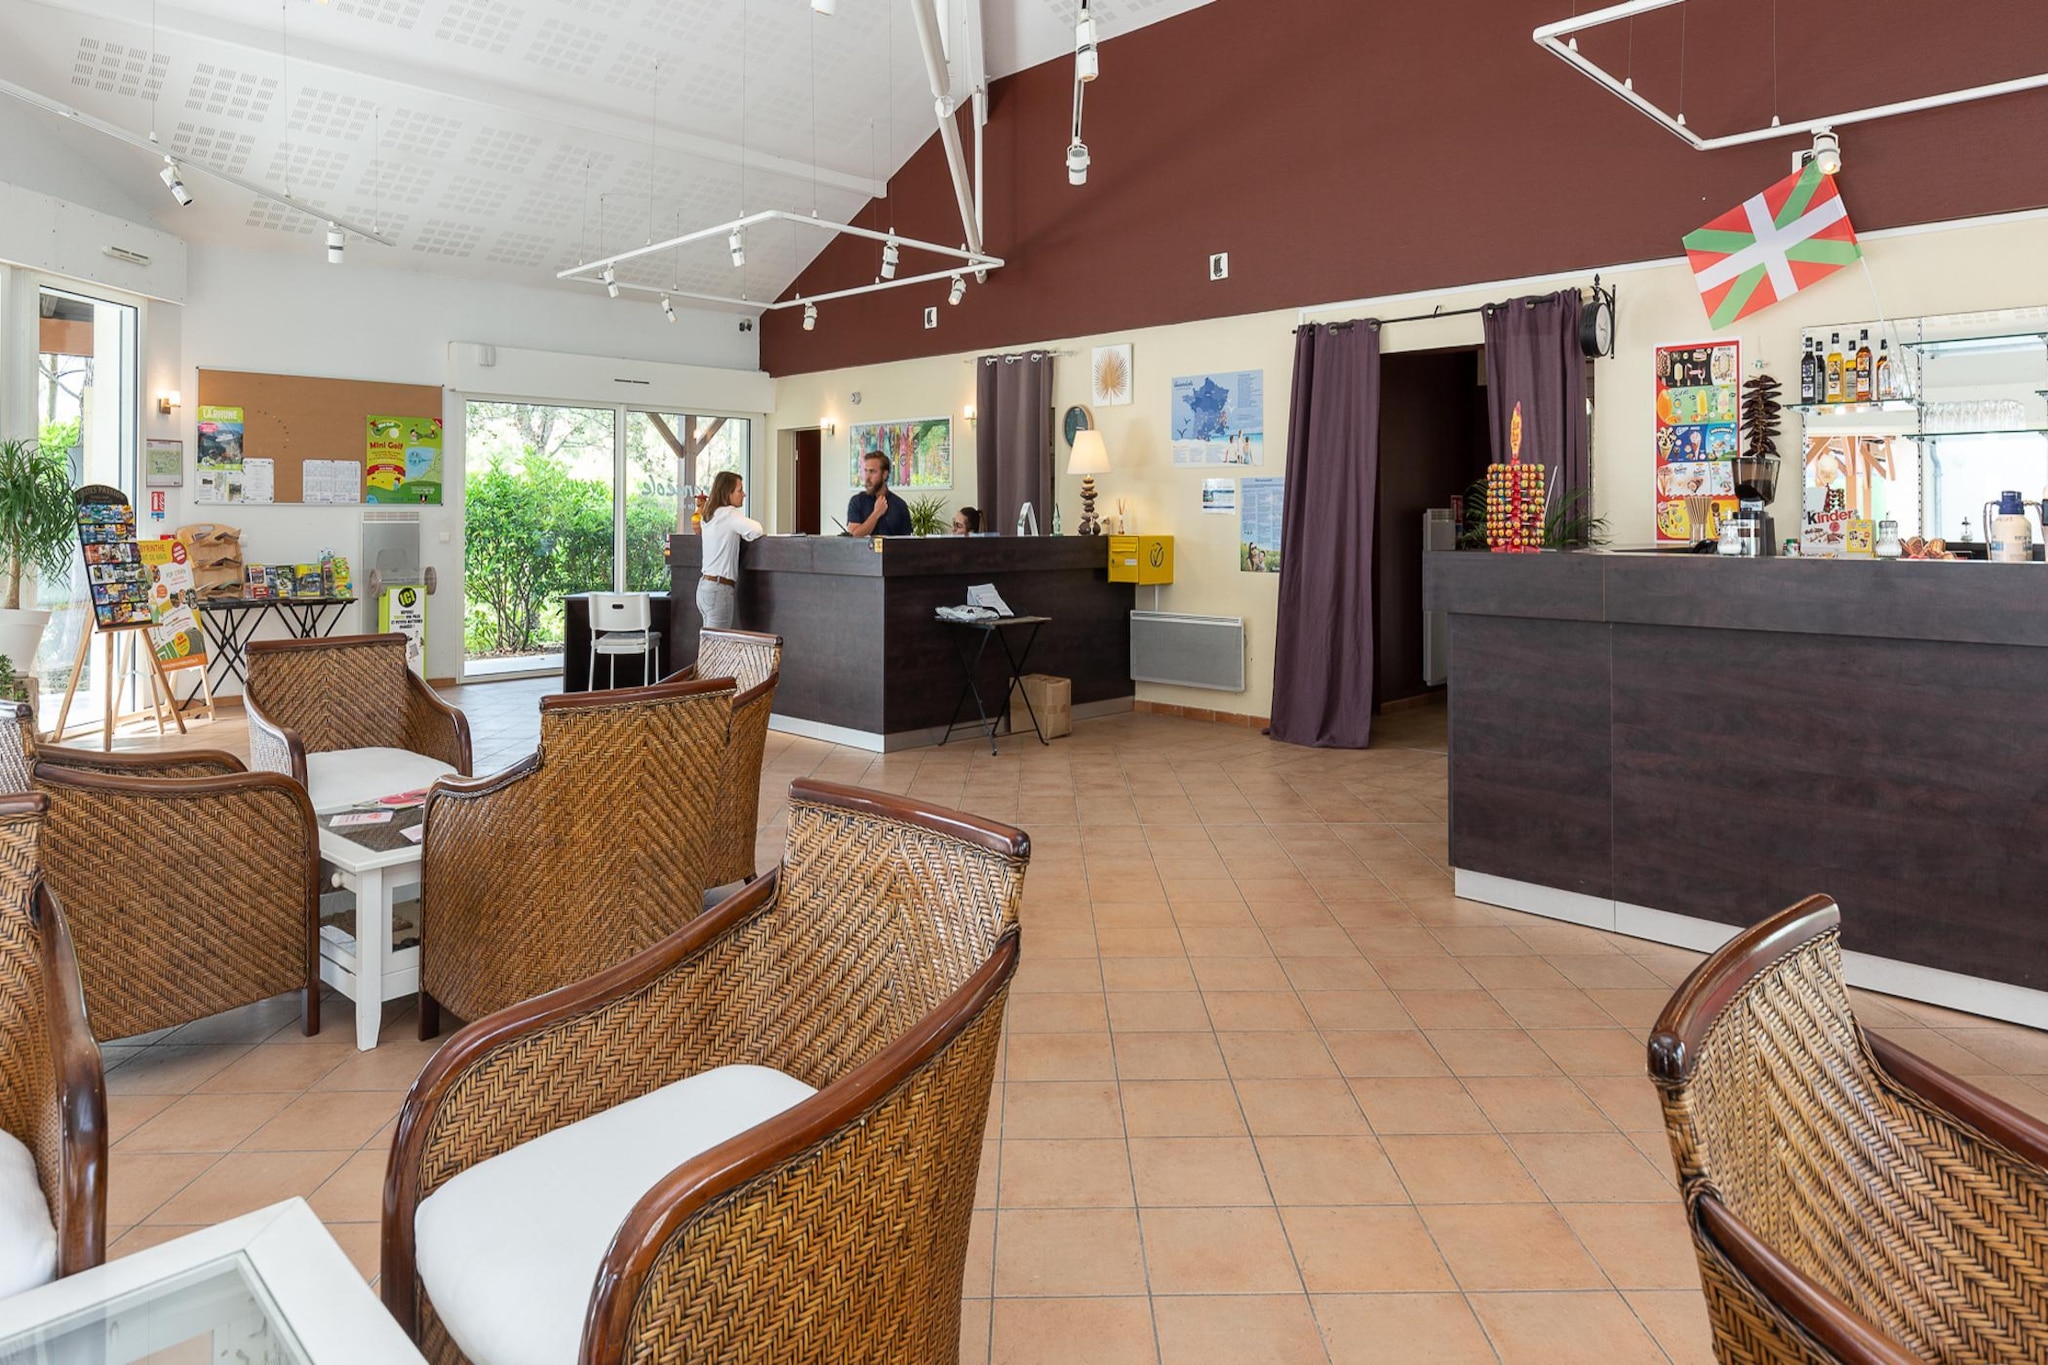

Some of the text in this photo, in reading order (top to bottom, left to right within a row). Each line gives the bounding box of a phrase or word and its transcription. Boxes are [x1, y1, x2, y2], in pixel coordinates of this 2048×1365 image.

[213, 409, 238, 420] RHUNE
[370, 441, 404, 450] Mini Golf
[400, 590, 416, 606] ICI
